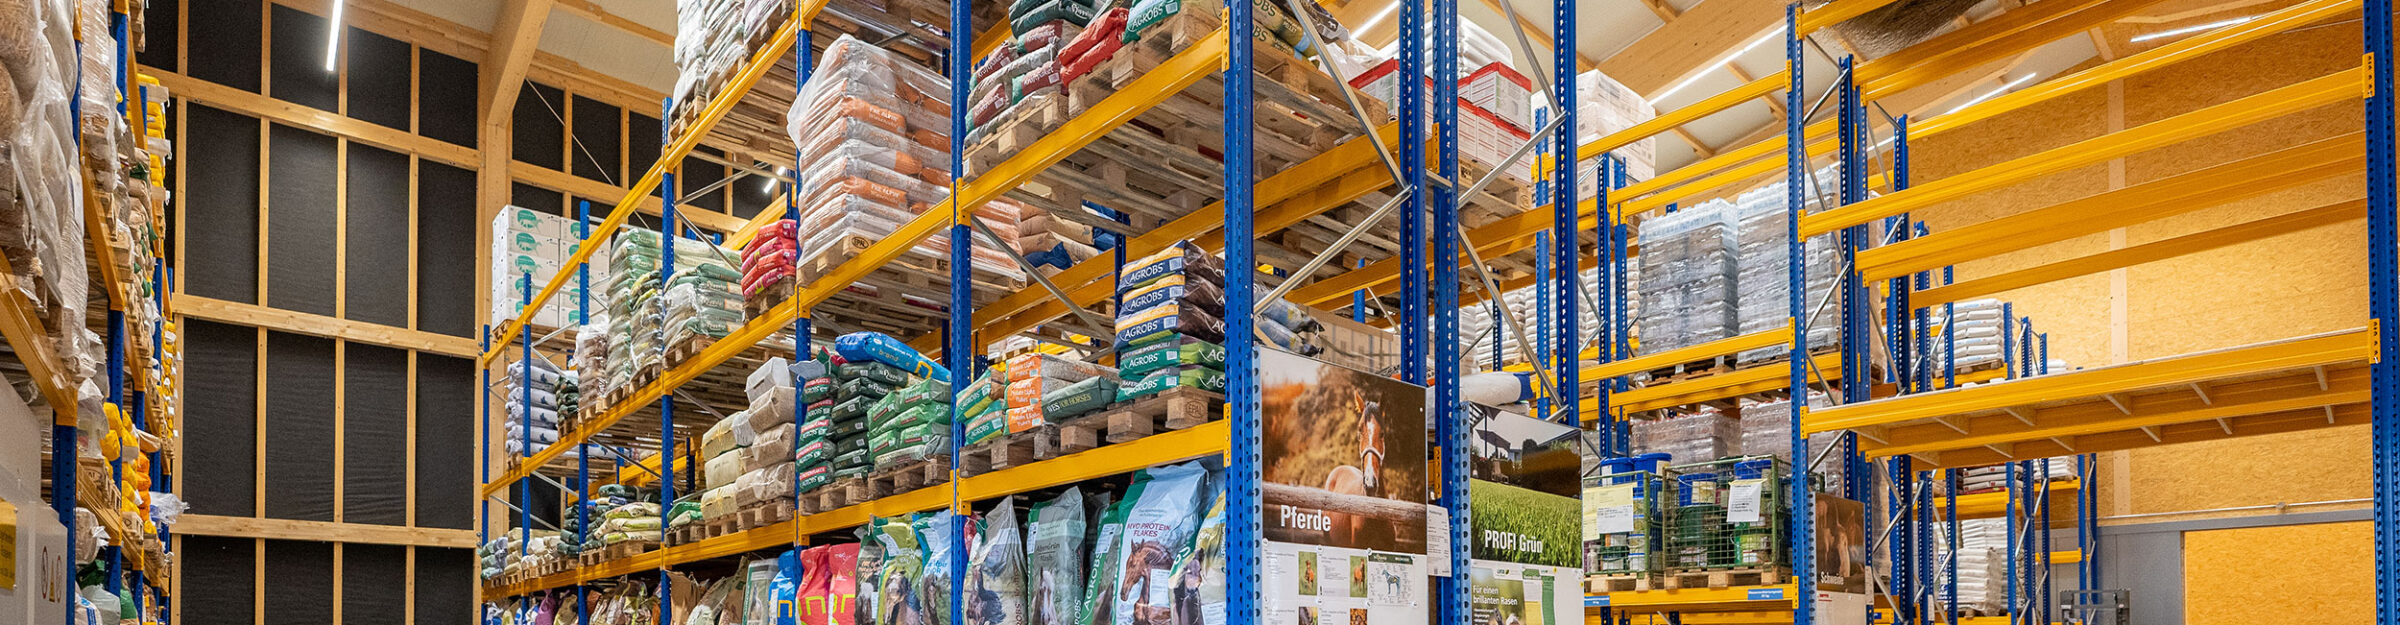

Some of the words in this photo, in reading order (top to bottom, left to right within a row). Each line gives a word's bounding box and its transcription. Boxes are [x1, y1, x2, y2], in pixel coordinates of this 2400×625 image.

[1131, 4, 1164, 30] AGROBS
[1128, 263, 1164, 285] AGROBS
[1129, 291, 1163, 310] AGROBS
[1125, 321, 1158, 341] AGROBS
[1128, 353, 1158, 368] AGROBS
[1280, 504, 1332, 532] Pferde
[1133, 529, 1158, 537] FLAKES
[1484, 529, 1517, 551] PROFI
[1519, 533, 1543, 553] Grün
[1472, 585, 1482, 594] Für
[1483, 585, 1499, 594] einen
[1473, 595, 1500, 605] brillanten
[1500, 596, 1518, 606] Rasen
